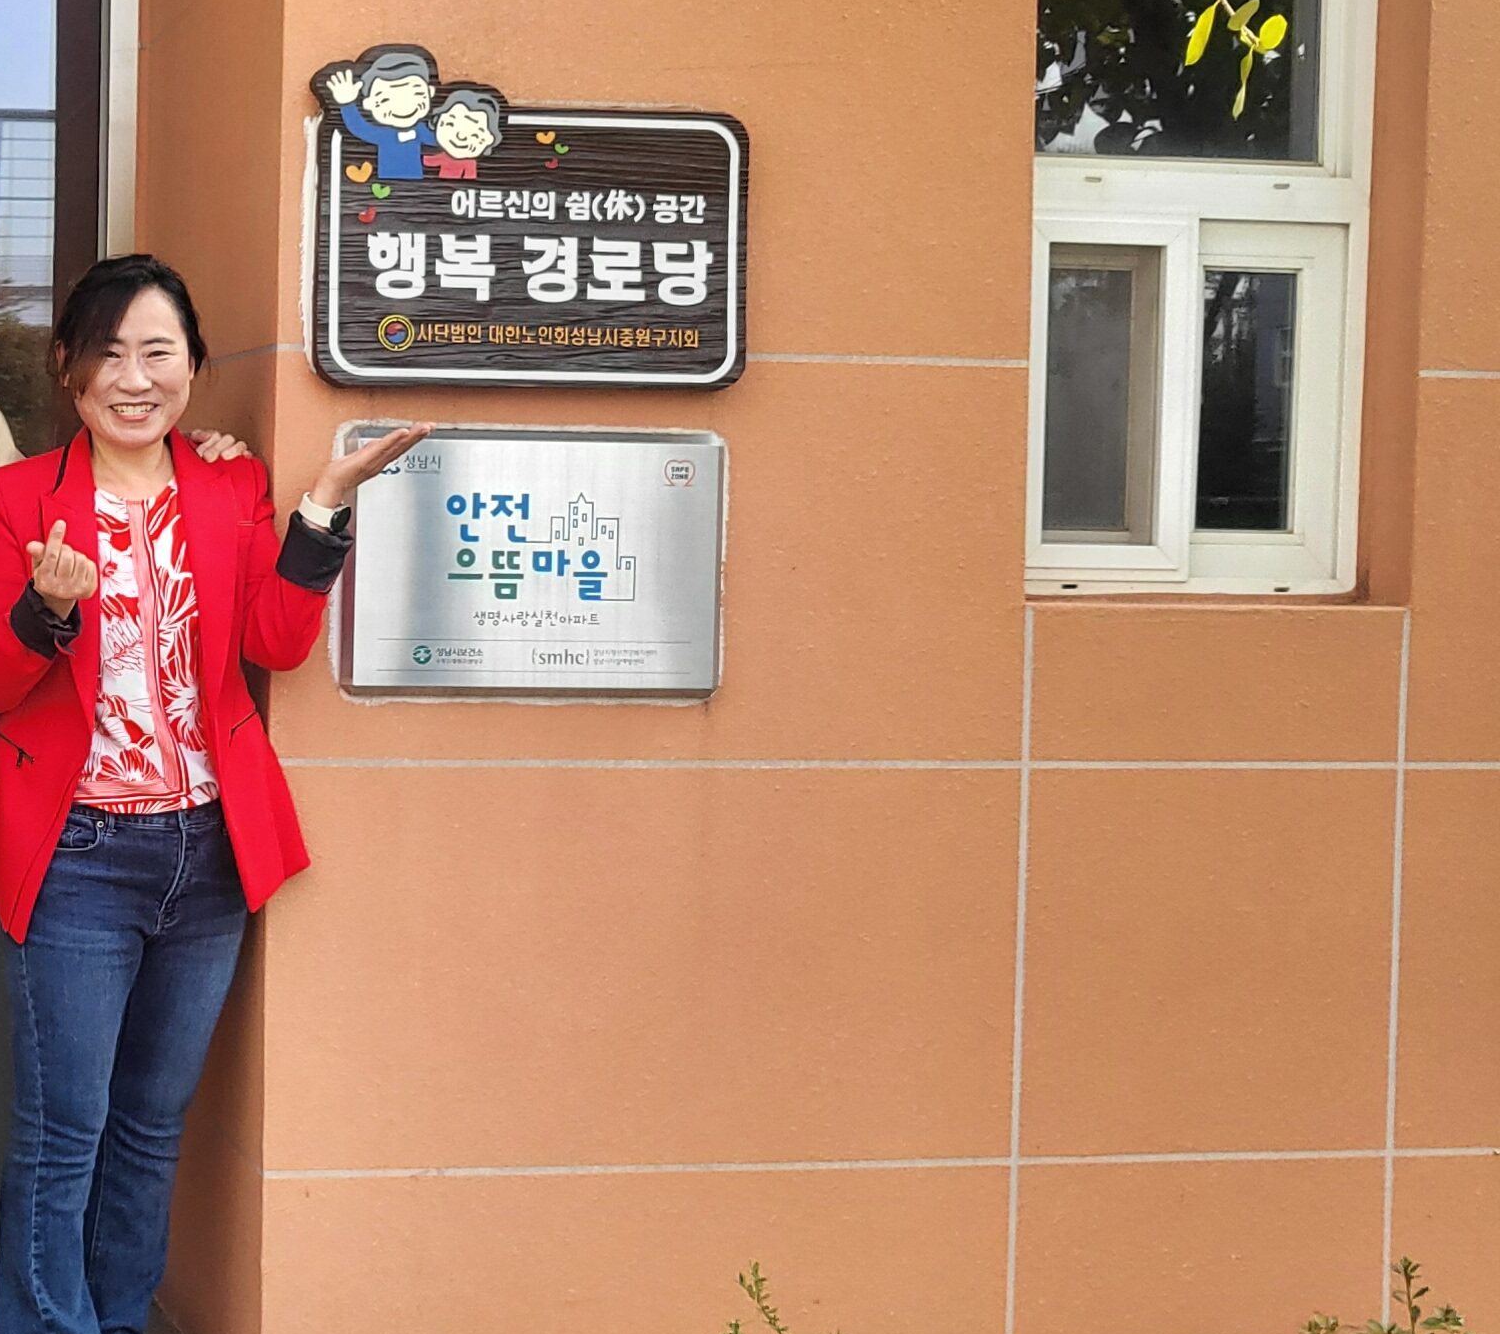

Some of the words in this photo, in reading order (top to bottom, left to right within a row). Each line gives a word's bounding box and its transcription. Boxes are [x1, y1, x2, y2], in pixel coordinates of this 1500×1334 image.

[451, 189, 556, 220] 어르신의
[564, 189, 646, 222] 쉼(休)
[652, 194, 706, 224] 공간
[367, 231, 496, 301] 행복
[521, 235, 713, 307] 경로당
[417, 323, 482, 344] 사단법인
[488, 324, 699, 349] 대한노인회성남시중원구지회
[404, 454, 441, 469] 성남시
[446, 492, 530, 543] 안전
[436, 647, 484, 657] 성남시보건소
